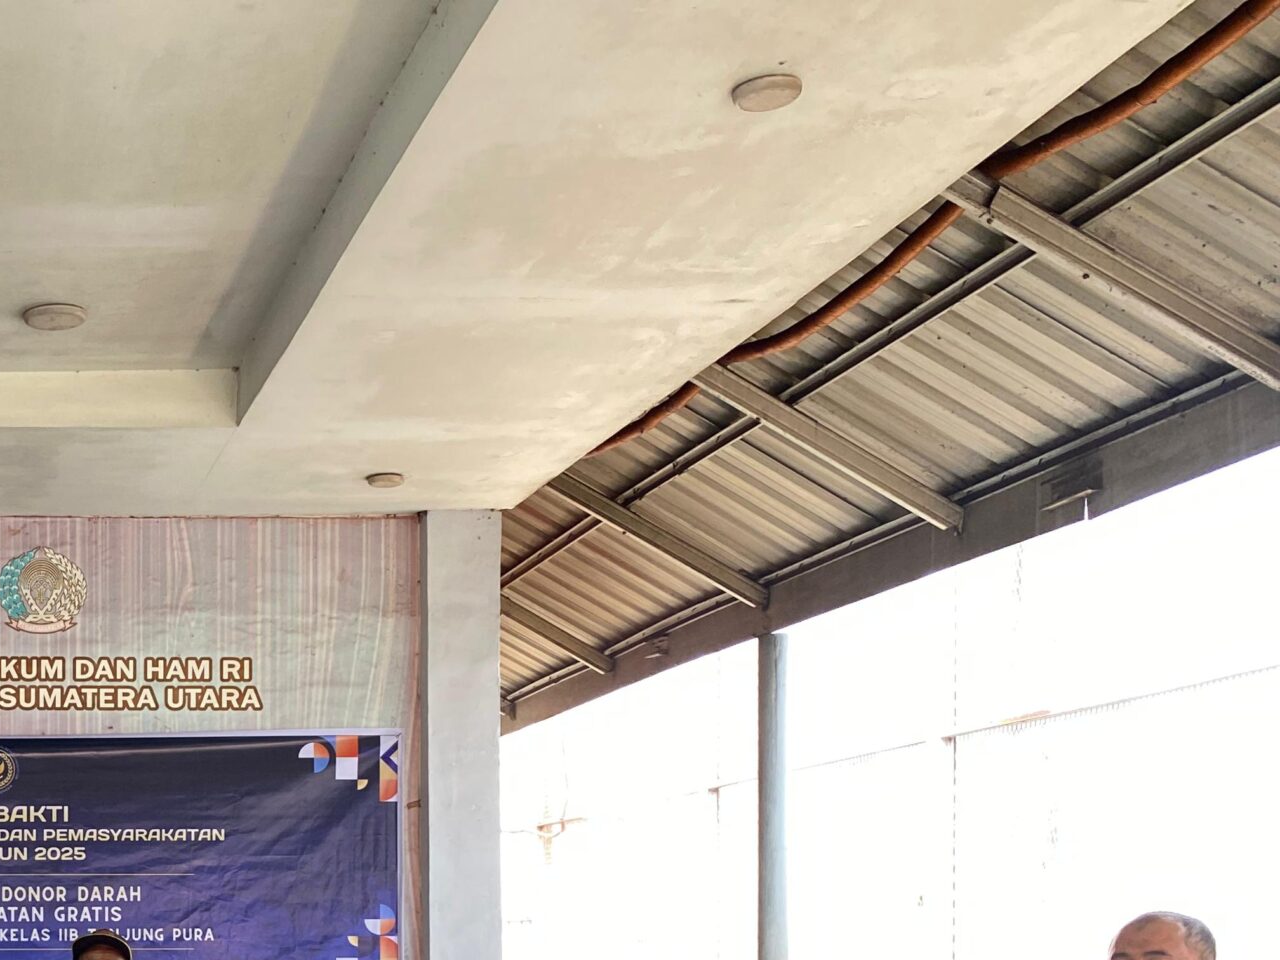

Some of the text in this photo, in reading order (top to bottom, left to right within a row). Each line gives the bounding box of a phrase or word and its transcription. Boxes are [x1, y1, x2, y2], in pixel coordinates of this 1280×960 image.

[74, 657, 135, 681] DAN
[145, 657, 211, 681] HAM
[222, 657, 252, 681] RI
[167, 687, 262, 711] UTARA
[43, 828, 226, 842] PEMASYARAKATAN
[34, 846, 87, 861] 2025
[1, 886, 67, 902] DONOR
[77, 886, 142, 902] DARAH
[54, 907, 122, 922] GRATIS
[0, 928, 51, 942] KELAS
[58, 928, 79, 942] IIB
[87, 928, 164, 942] TJUNG
[172, 928, 215, 942] PURA
